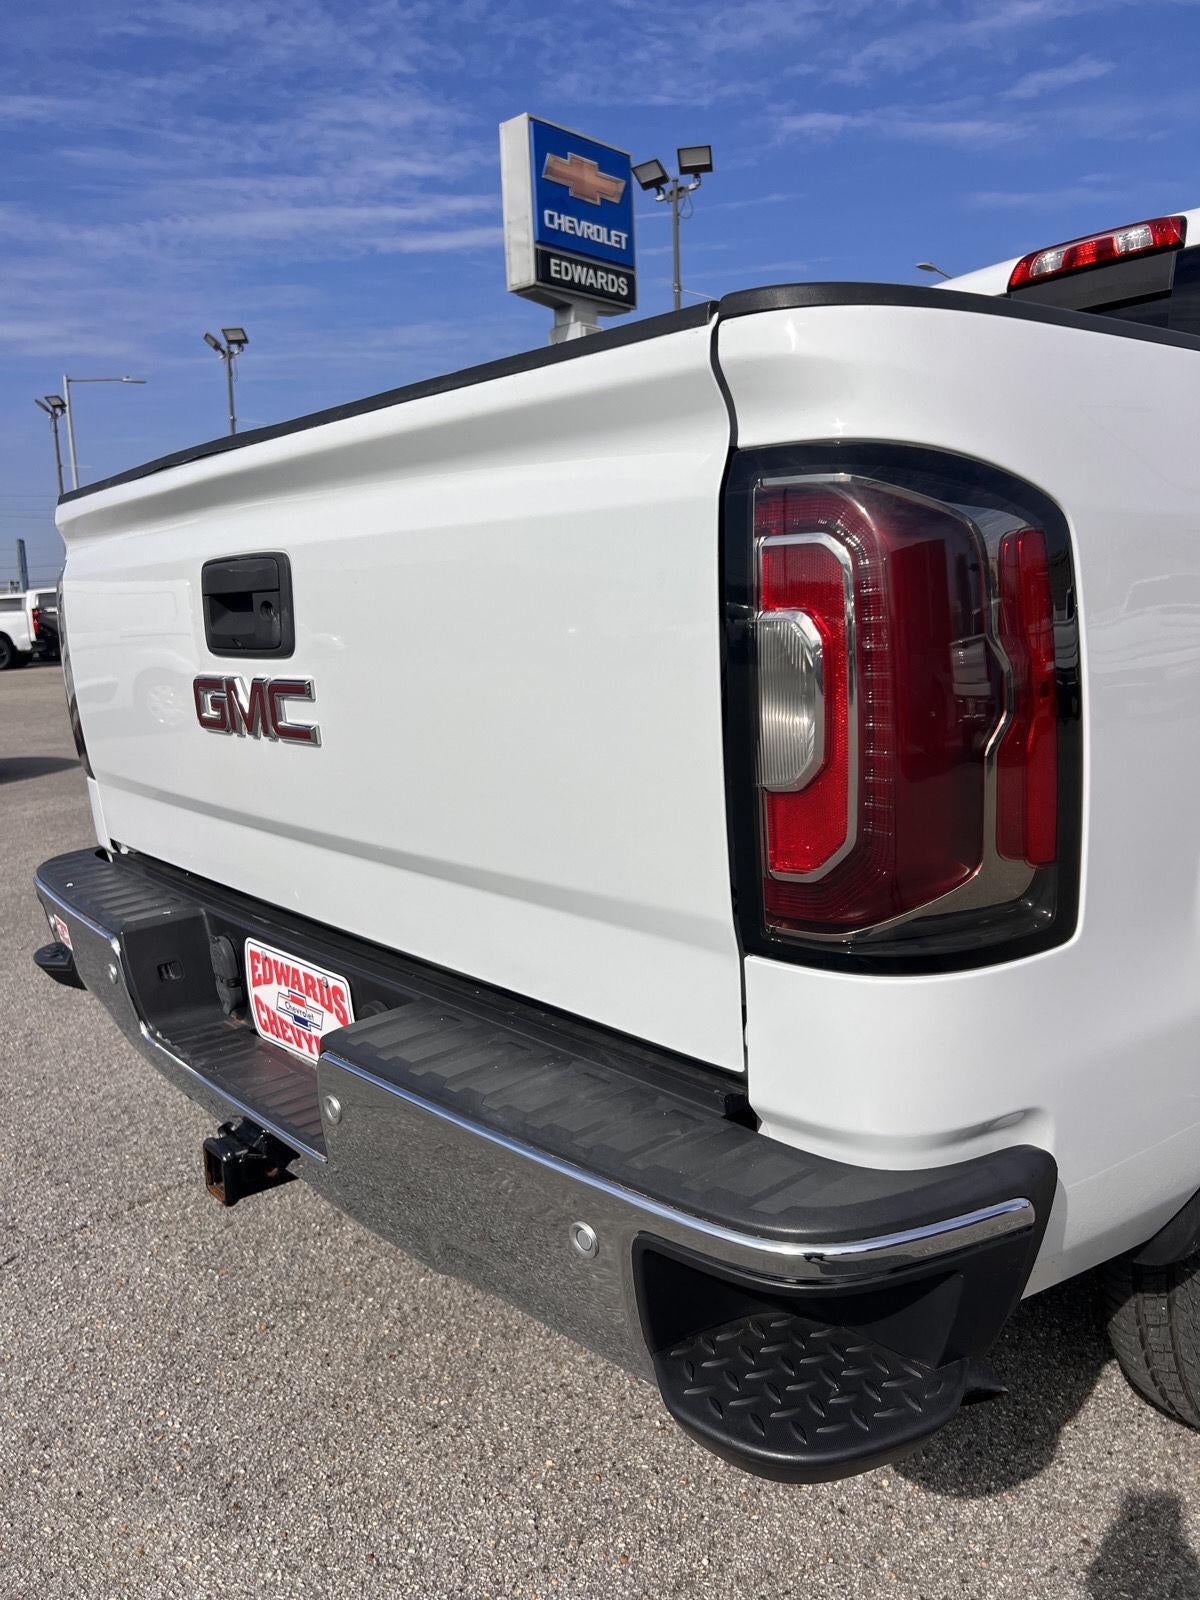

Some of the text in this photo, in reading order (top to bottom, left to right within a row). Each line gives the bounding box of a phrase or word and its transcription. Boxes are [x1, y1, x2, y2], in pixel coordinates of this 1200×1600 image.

[544, 210, 628, 250] CHEVROLET
[550, 258, 628, 296] EDWARDS
[193, 674, 322, 748] GMC
[250, 949, 349, 1027] EDWARDS
